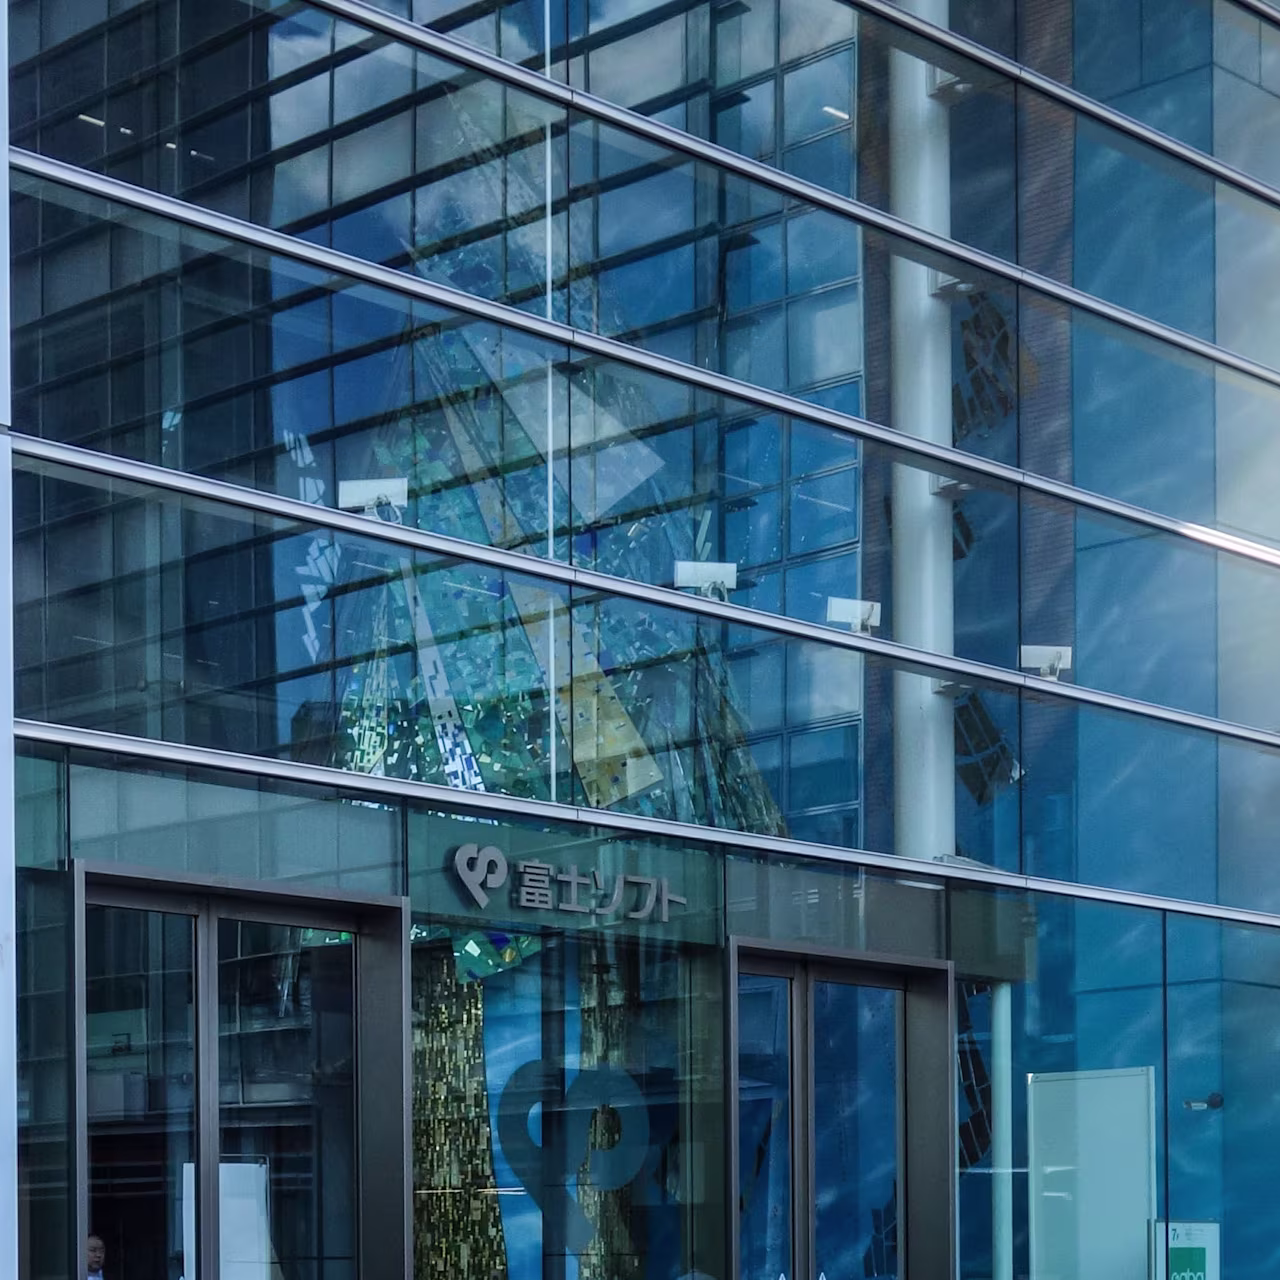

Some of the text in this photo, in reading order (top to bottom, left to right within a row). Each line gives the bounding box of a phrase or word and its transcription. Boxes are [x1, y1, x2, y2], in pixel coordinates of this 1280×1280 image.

[517, 858, 687, 922] 富士ソフト
